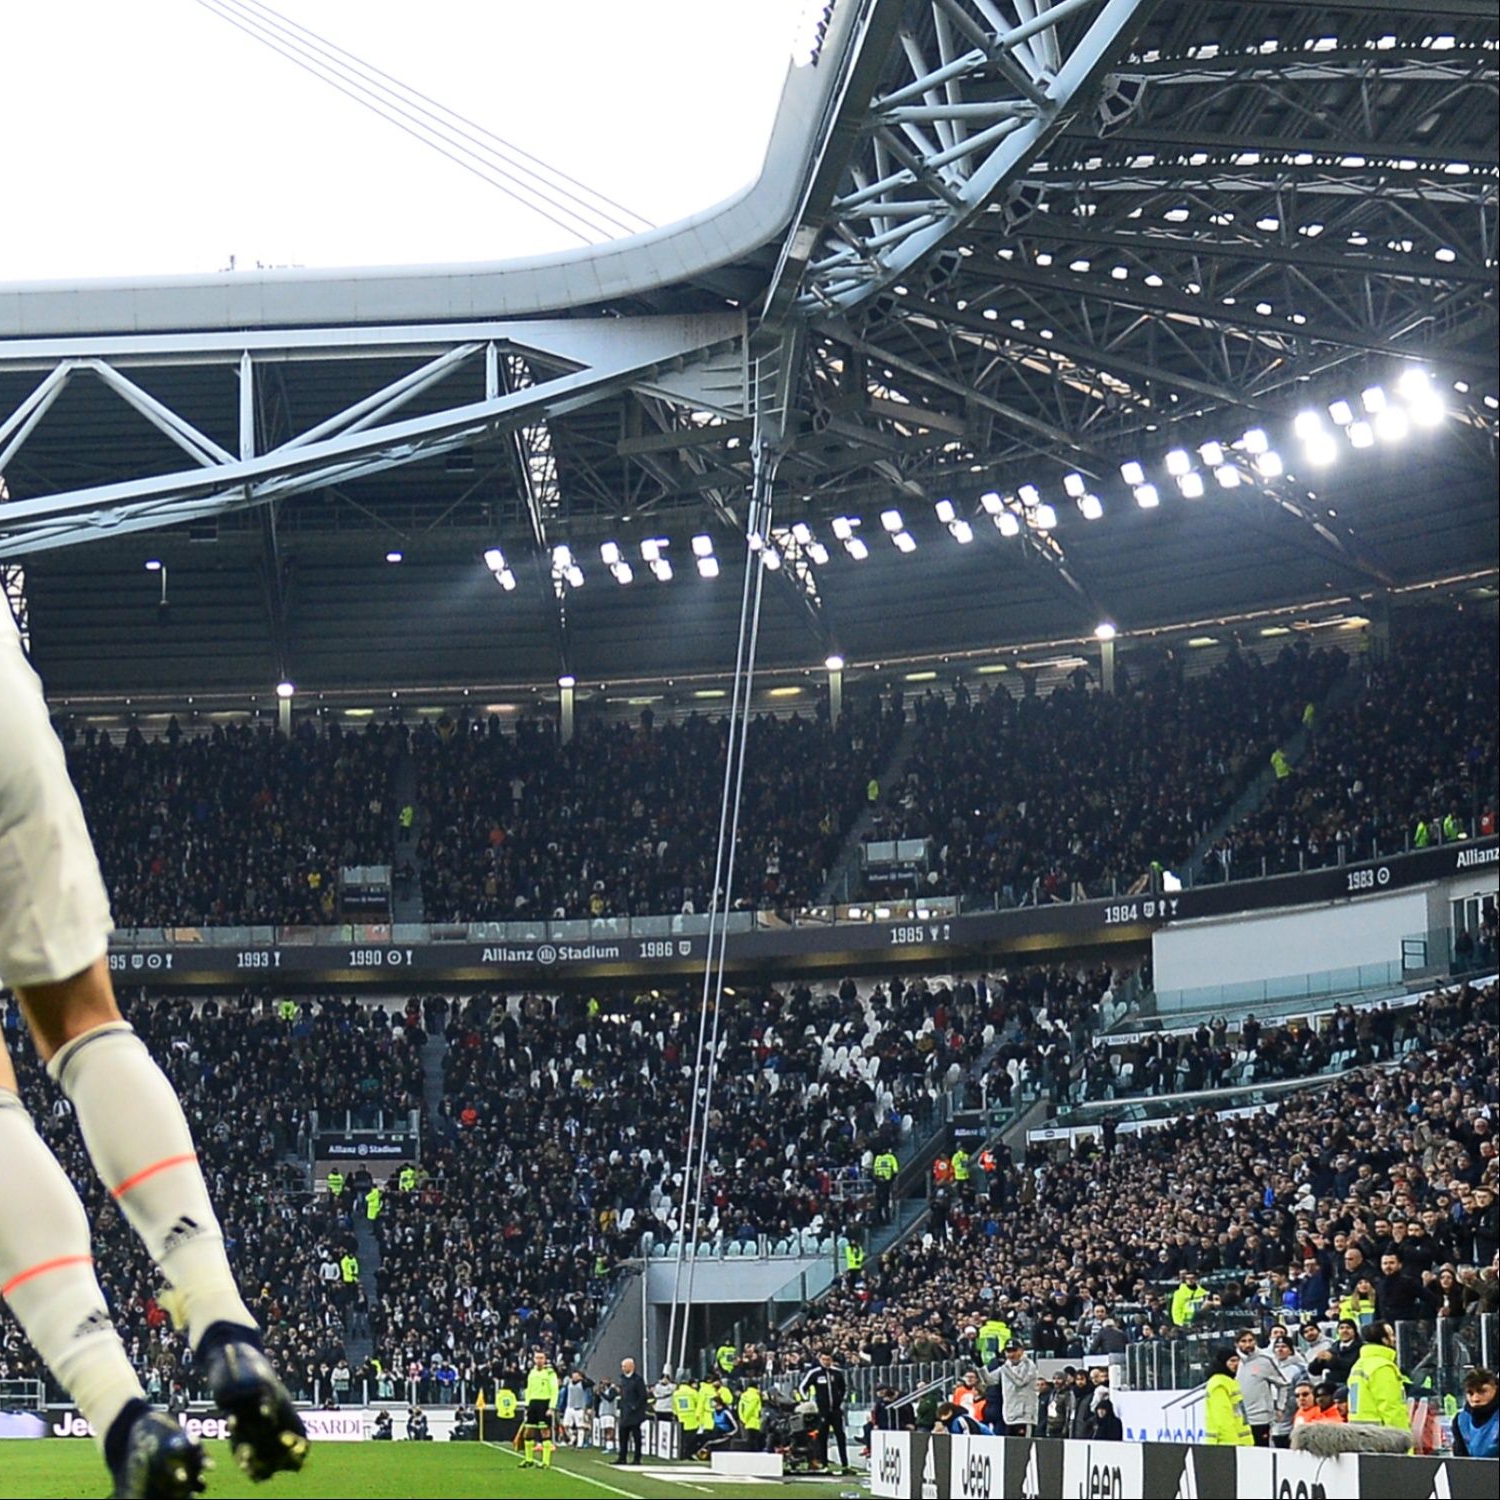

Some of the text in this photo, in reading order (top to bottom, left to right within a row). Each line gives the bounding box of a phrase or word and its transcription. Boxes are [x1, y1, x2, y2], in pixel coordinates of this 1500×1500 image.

[1456, 847, 1499, 868] Allianz
[1347, 870, 1374, 890] 1983
[1104, 904, 1138, 924] 1984
[890, 926, 924, 944] 1985
[482, 945, 619, 962] Allianz Stadium
[639, 941, 673, 957] 1986
[106, 954, 126, 970] 95
[237, 952, 269, 967] 1993
[349, 951, 382, 966] 1990
[328, 1144, 402, 1153] Allianz Stadium
[303, 1419, 360, 1434] SARDI
[879, 1433, 901, 1496] Jeep
[962, 1437, 991, 1499] Jeep
